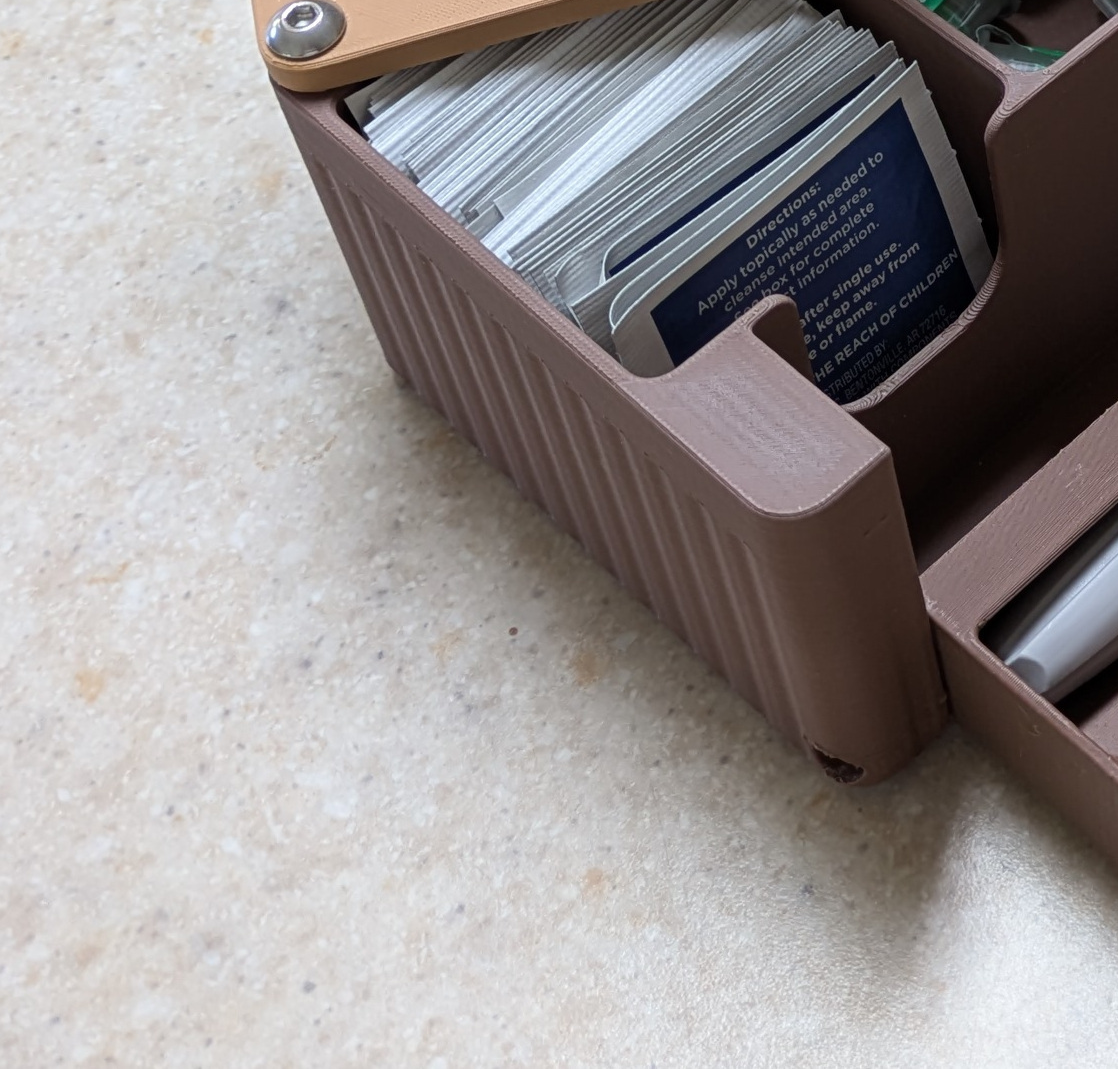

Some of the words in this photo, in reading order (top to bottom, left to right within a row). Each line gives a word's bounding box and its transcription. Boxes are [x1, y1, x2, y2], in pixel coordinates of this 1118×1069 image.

[697, 275, 738, 315] Apply
[739, 222, 799, 278] topically
[801, 209, 817, 226] as
[818, 162, 867, 212] needed
[867, 152, 884, 168] to
[724, 265, 776, 312] cleanse
[777, 211, 838, 267] intended
[839, 187, 872, 216] area.
[746, 181, 822, 249] Directions:
[761, 274, 789, 298] box
[789, 254, 811, 276] for
[813, 202, 875, 258] complete
[797, 222, 880, 290] information.
[816, 300, 851, 333] keep
[852, 270, 886, 303] away
[887, 242, 921, 274] from
[832, 263, 873, 300] single
[874, 242, 902, 266] use.
[814, 360, 835, 383] HE
[834, 322, 879, 365] REACH
[879, 304, 898, 326] OF
[899, 248, 959, 309] CHILDREN
[819, 333, 834, 350] or
[835, 301, 878, 336] flame.
[919, 304, 947, 333] 72716
